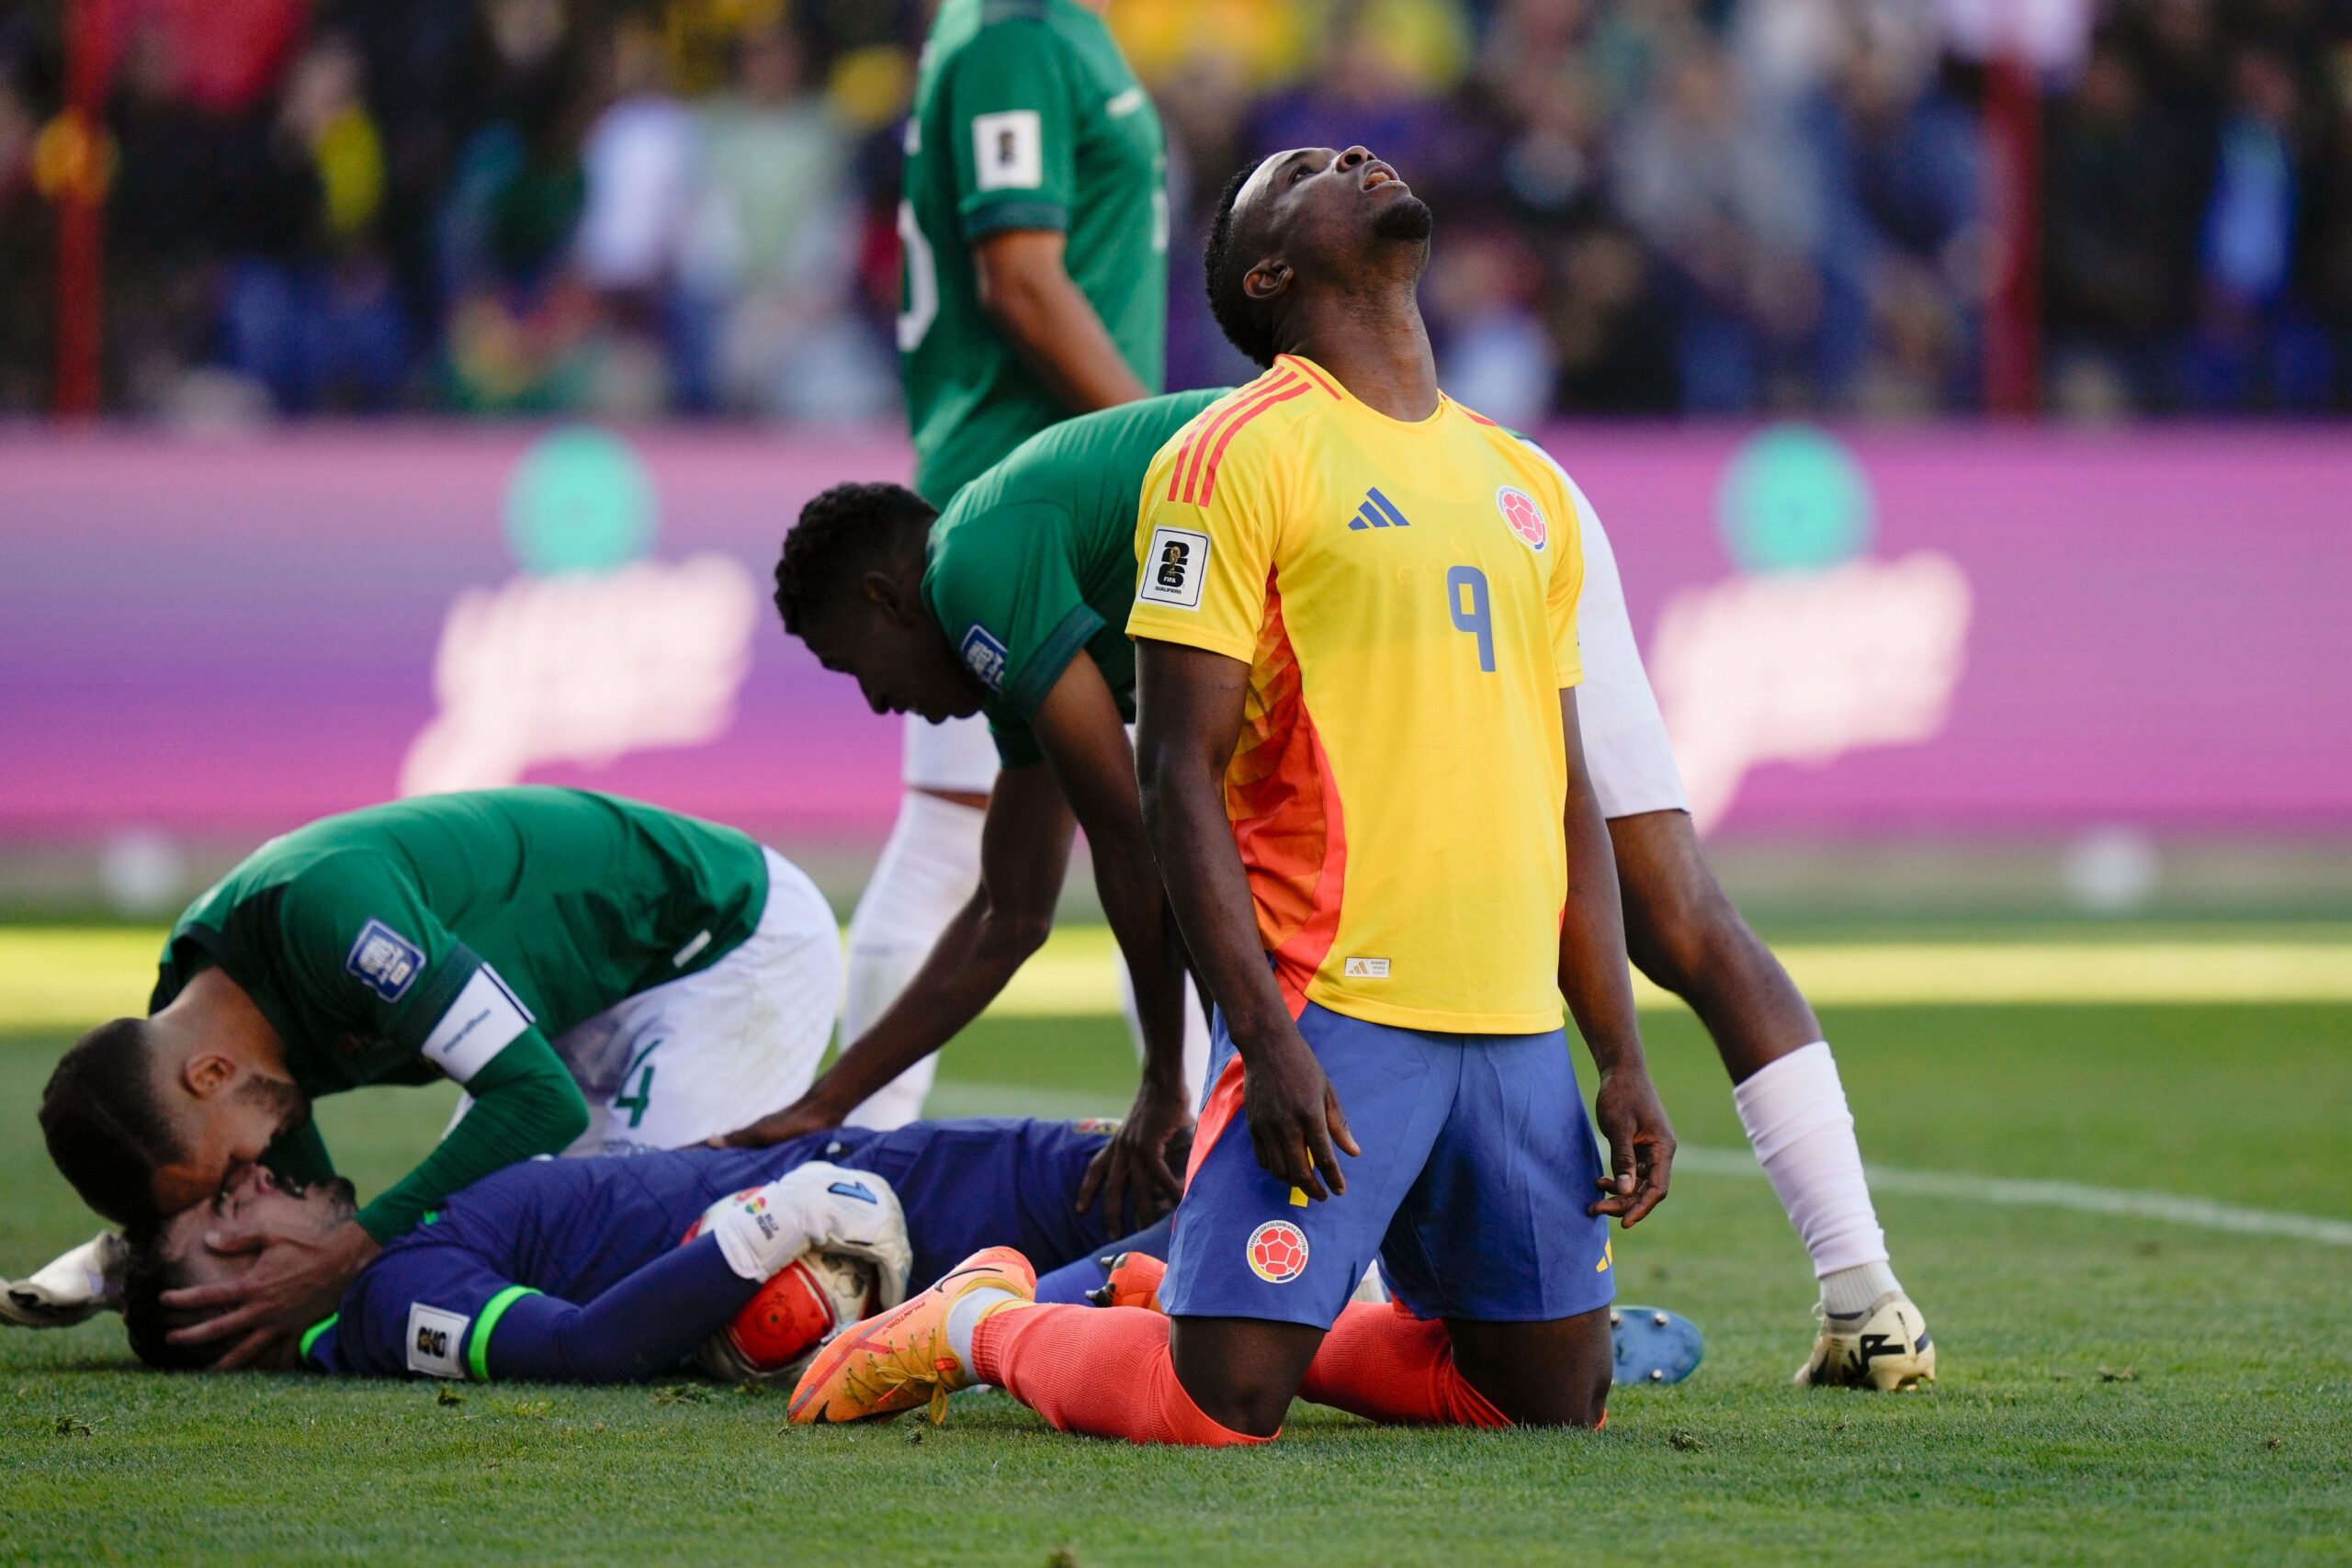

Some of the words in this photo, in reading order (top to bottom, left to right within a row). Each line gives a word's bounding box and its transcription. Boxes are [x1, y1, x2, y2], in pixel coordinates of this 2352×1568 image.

[1154, 585, 1182, 595] QUALIFIERS
[1163, 576, 1176, 584] FIFA
[1447, 565, 1496, 671] 9
[613, 1039, 663, 1129] 4
